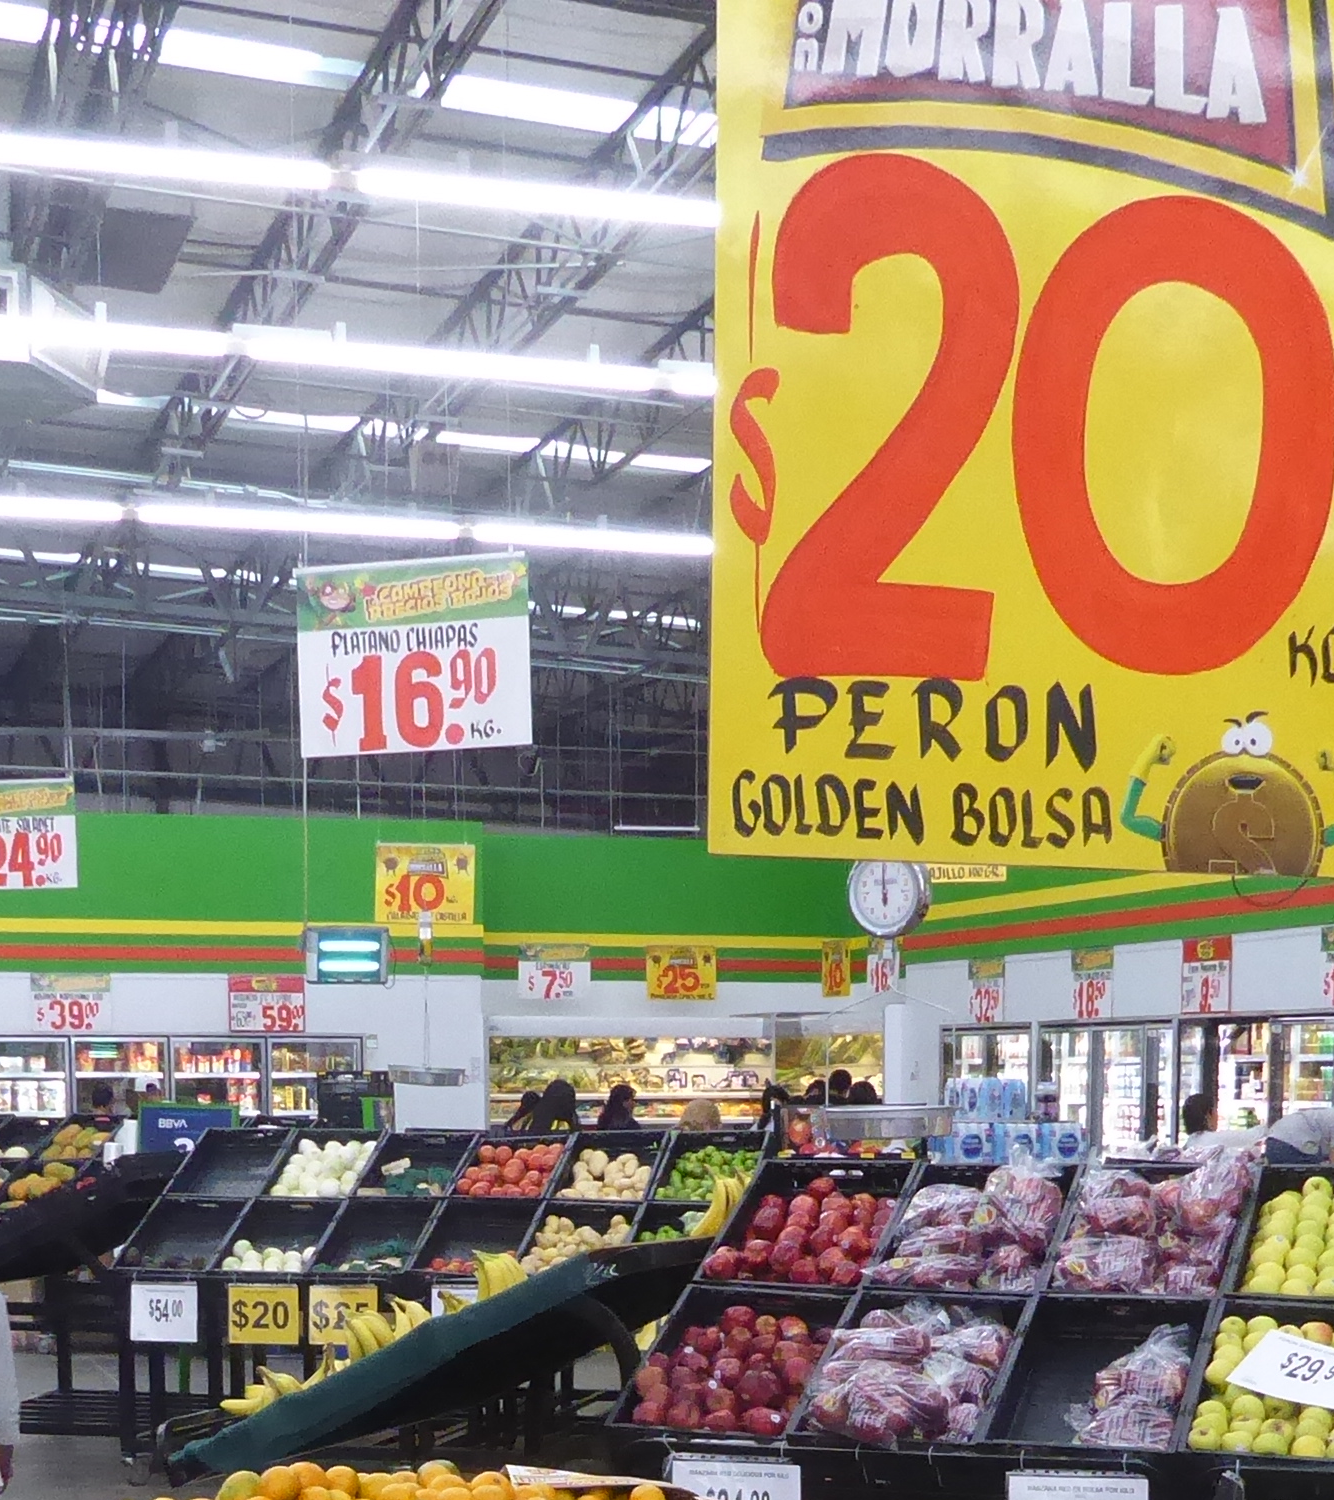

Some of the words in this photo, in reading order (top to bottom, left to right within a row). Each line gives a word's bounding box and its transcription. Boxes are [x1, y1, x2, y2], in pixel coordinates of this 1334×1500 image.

[331, 629, 401, 657] PLATANO
[407, 623, 479, 651] CHIAPAS
[471, 719, 502, 740] KG.
[767, 676, 1098, 773] PERON
[733, 769, 924, 845] GOLDEN
[950, 786, 1113, 848] BOLSA
[384, 874, 445, 912] $10
[158, 1118, 188, 1129] BBVA
[231, 1300, 290, 1331] $20
